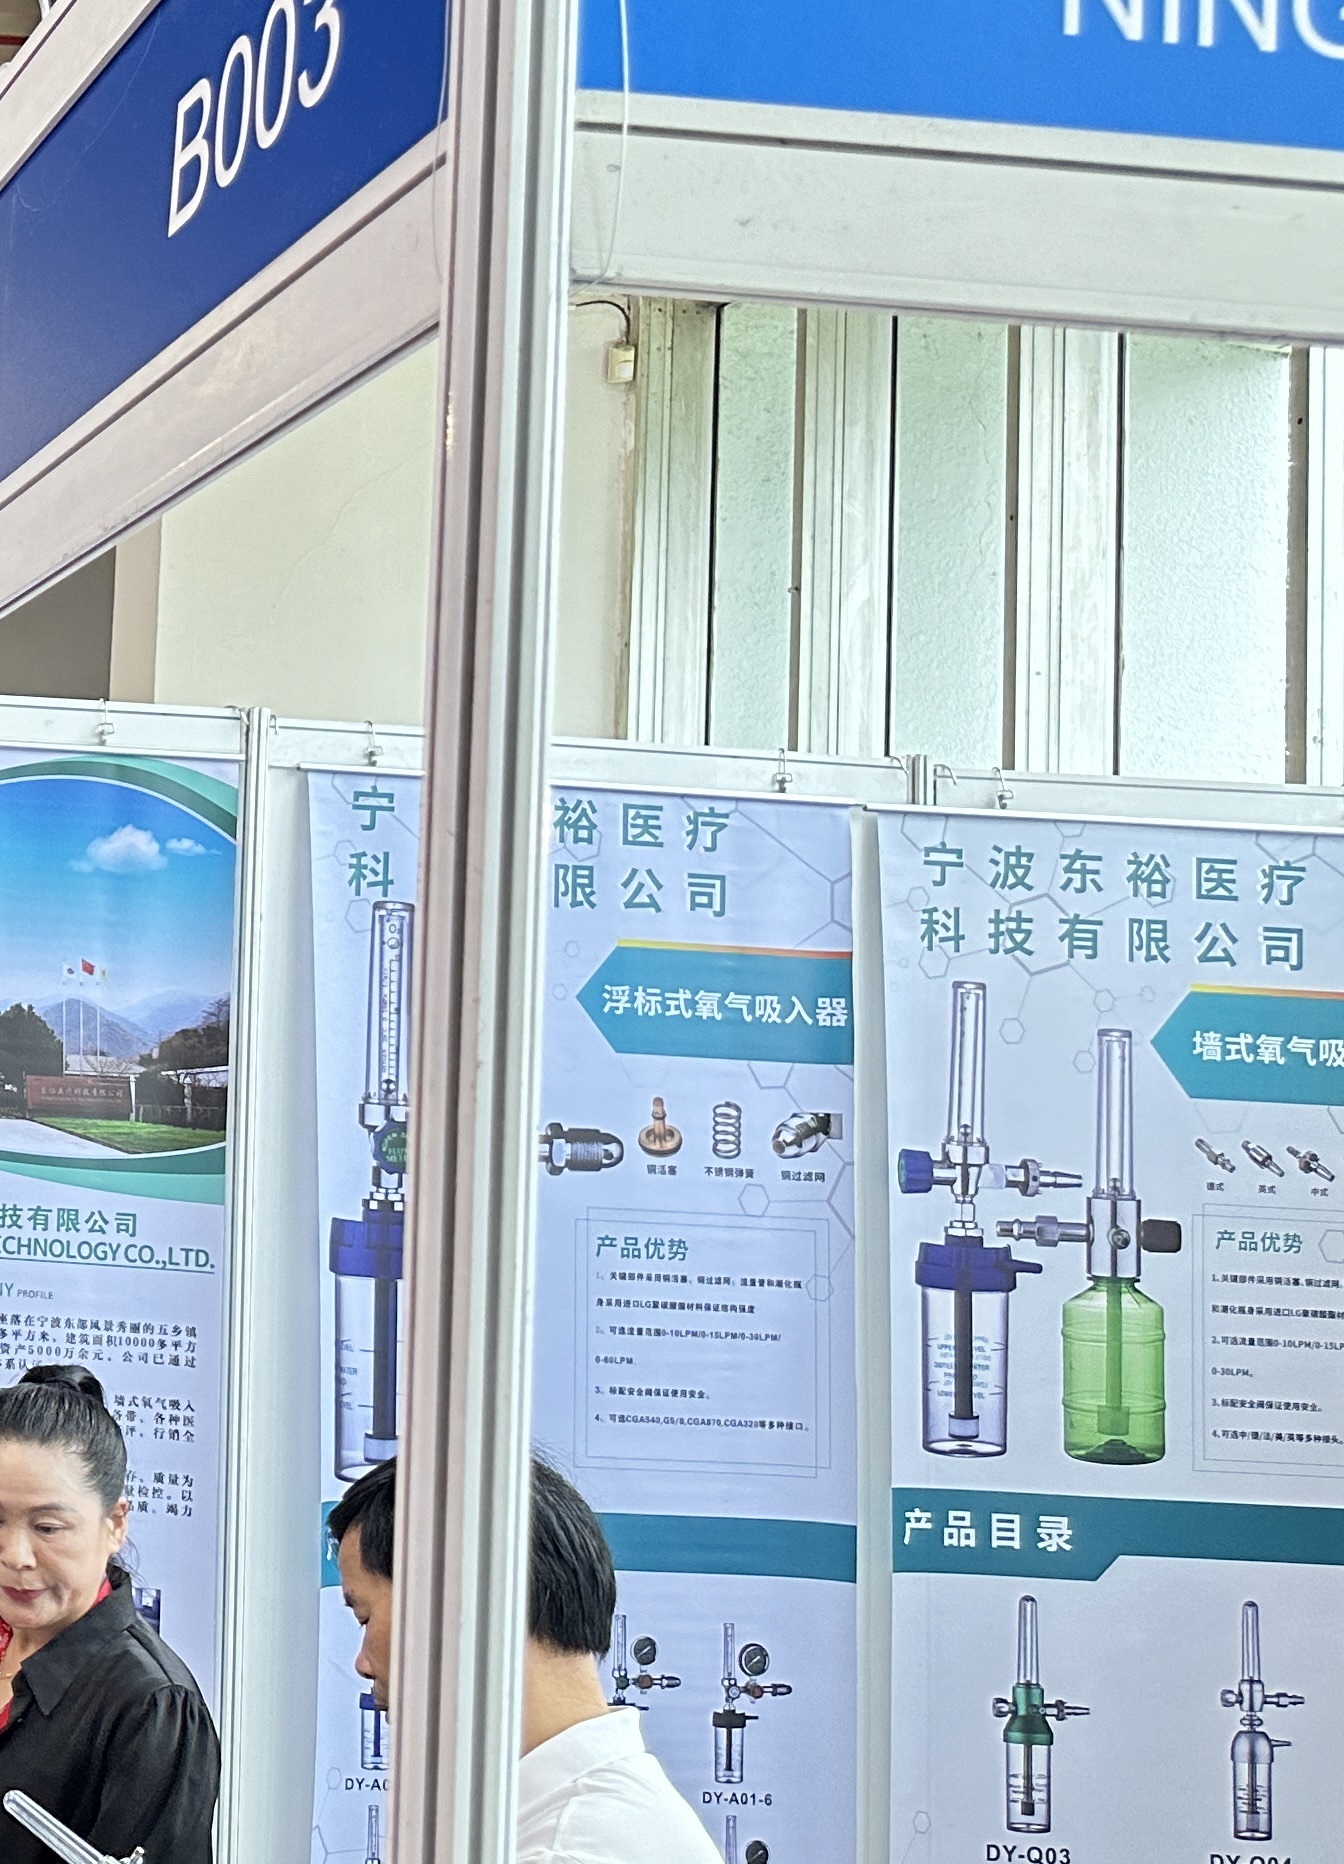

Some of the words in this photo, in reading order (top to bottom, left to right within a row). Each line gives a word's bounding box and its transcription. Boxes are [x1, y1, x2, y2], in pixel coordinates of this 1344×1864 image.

[168, 0, 340, 238] B003
[351, 785, 395, 832] 宁
[553, 797, 730, 853] 裕医疗
[347, 851, 395, 898] 科
[553, 863, 726, 918] 限公司
[923, 841, 1307, 907] 宁波东裕医疗
[920, 906, 1304, 972] 科技有限公司
[602, 984, 849, 1028] 浮标式氧气吸入器
[595, 1234, 689, 1262] 产品优势
[1215, 1229, 1304, 1255] 产品优势
[17, 1289, 54, 1300] PROFILE
[903, 1507, 1074, 1553] 产品目录
[702, 1791, 773, 1807] DY-A01-6
[985, 1844, 1072, 1864] DY-Q03
